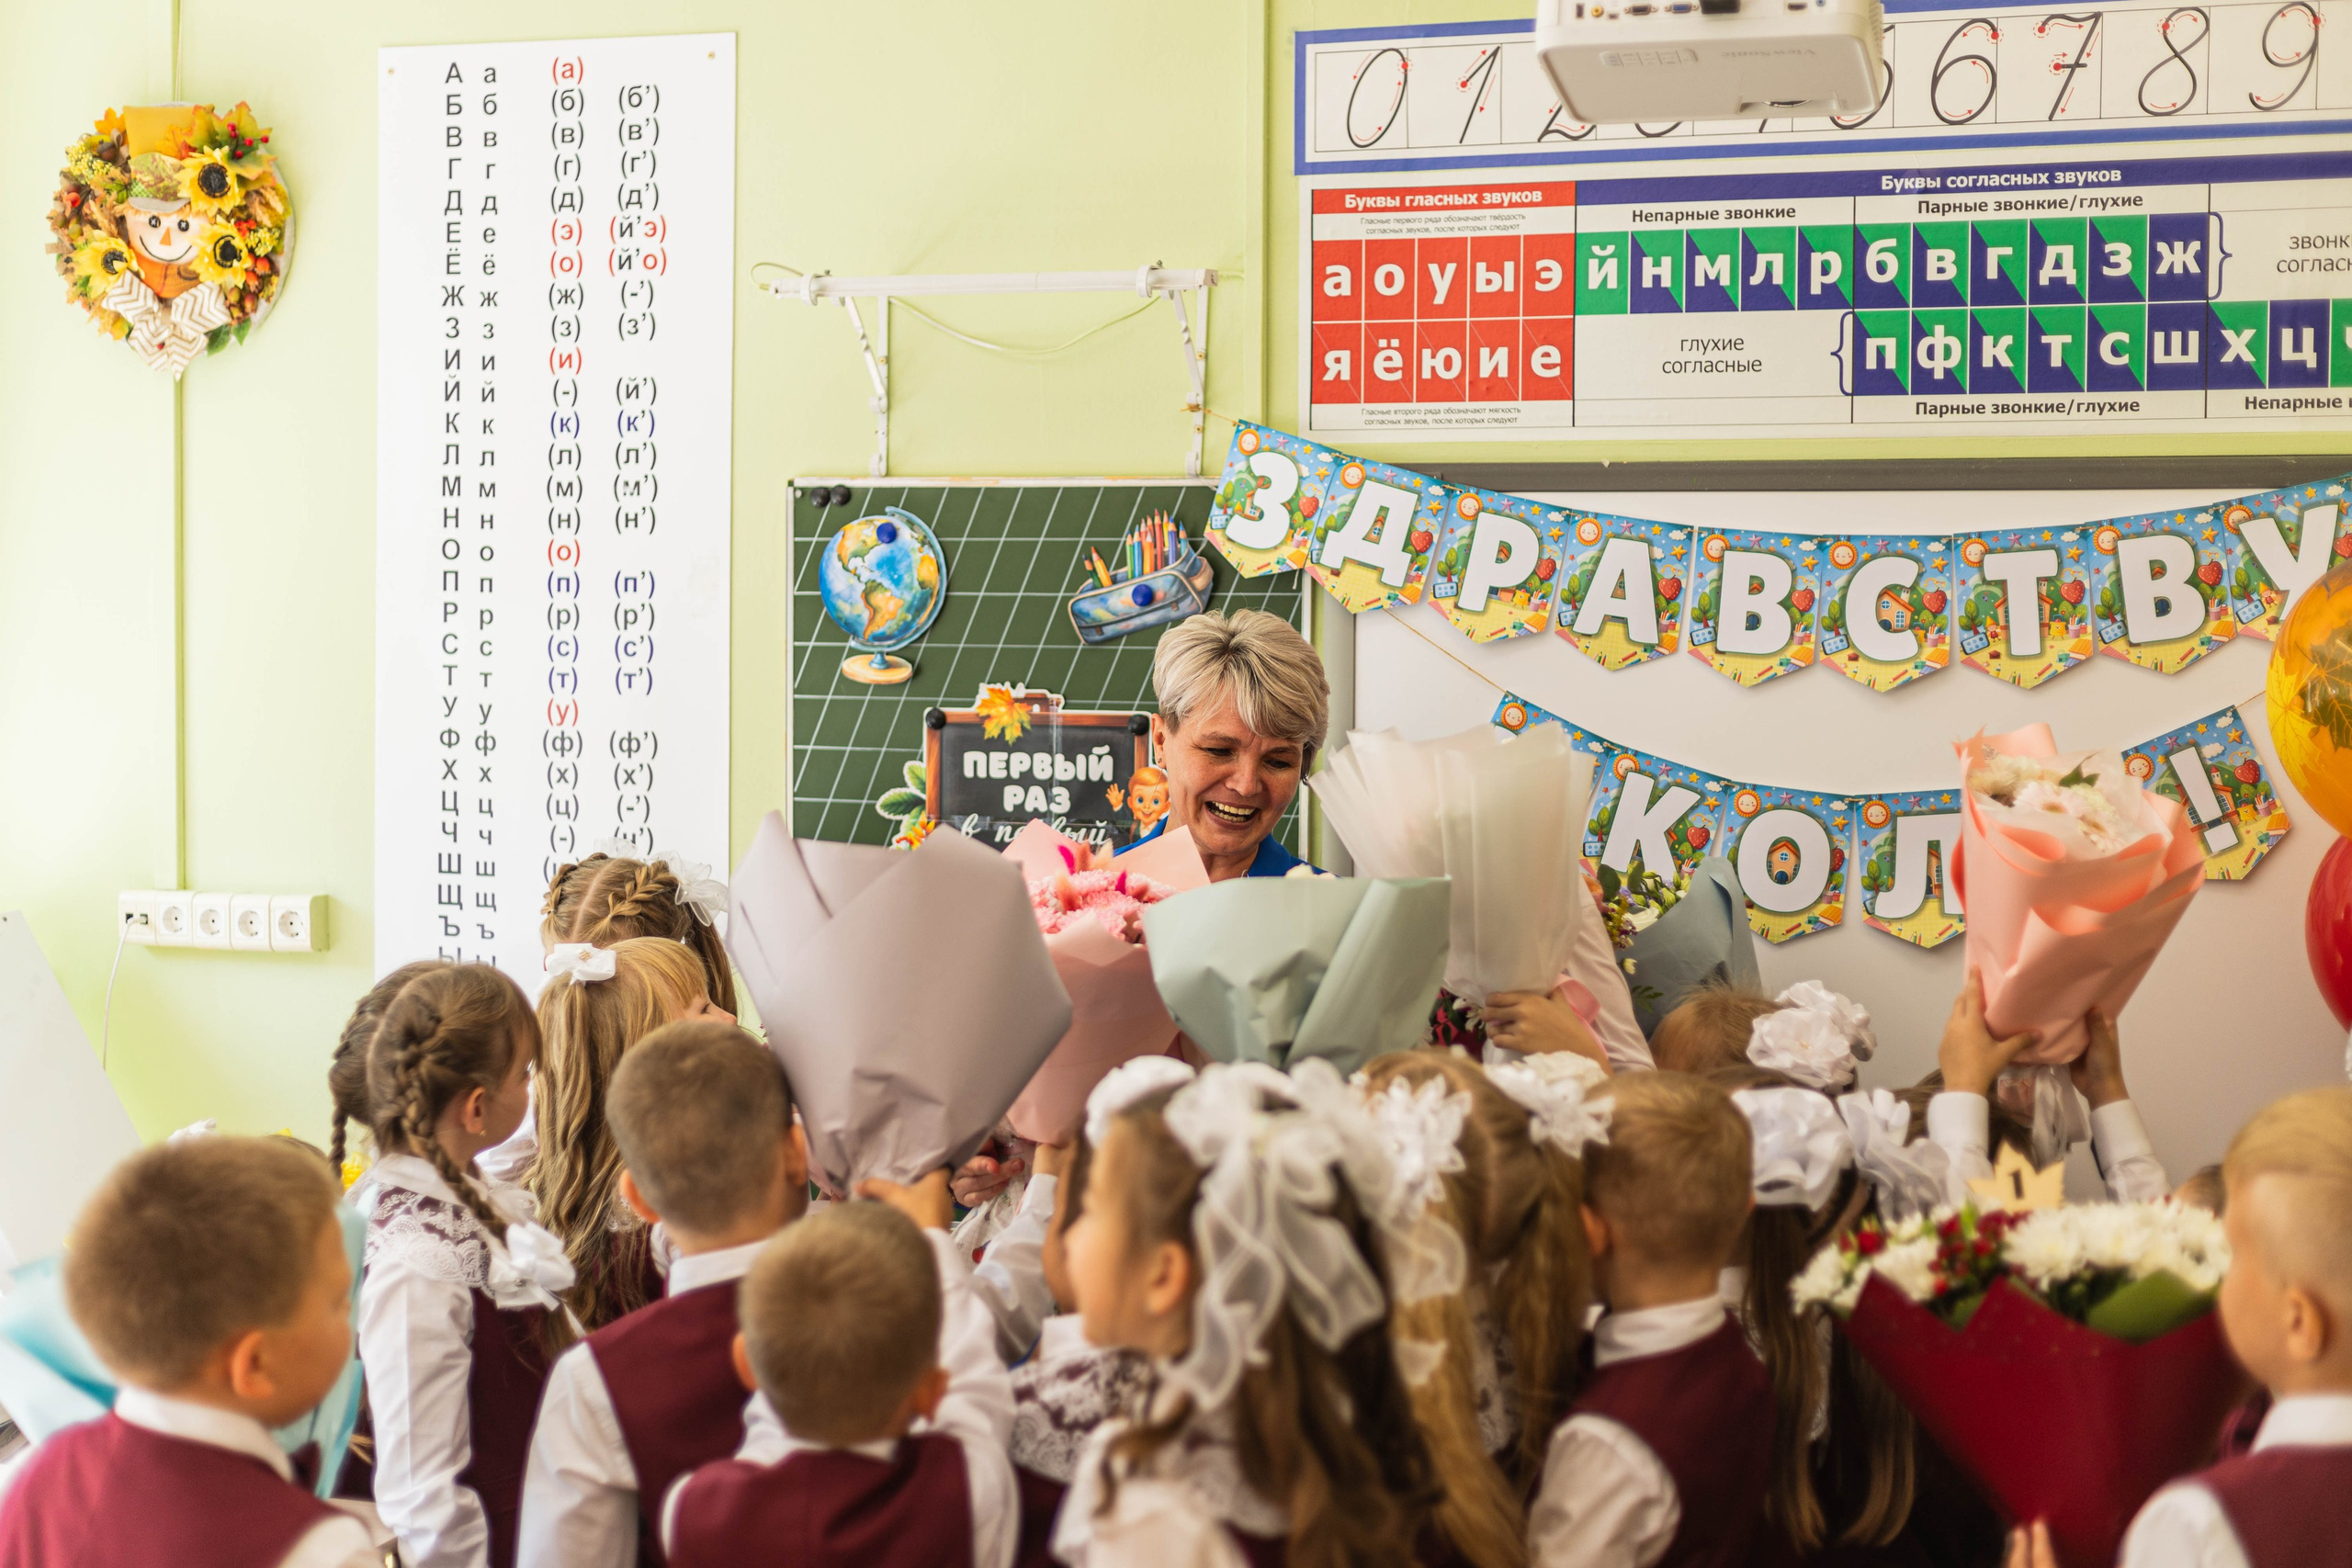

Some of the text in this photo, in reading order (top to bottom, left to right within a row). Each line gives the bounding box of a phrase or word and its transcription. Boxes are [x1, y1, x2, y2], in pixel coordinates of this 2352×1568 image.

[444, 56, 584, 86] А а (а)
[1346, 48, 1408, 149] 0
[1459, 45, 1501, 144] 1
[1930, 17, 1998, 126] 6
[2041, 11, 2103, 122] 7
[2138, 6, 2211, 118] 8
[2248, 1, 2319, 112] 9
[446, 88, 584, 118] Б б (б)
[446, 120, 584, 151] В в (в)
[448, 152, 582, 183] Г г (г)
[1881, 169, 2122, 194] Буквы согласных звуков
[444, 185, 584, 217] Д д (д)
[1344, 190, 1543, 211] Буквы гласных звуков
[1917, 194, 2143, 217] Парные звонкие/глухие
[1360, 213, 1527, 225] Гласные первого ряда обозначают твёрдость
[1488, 223, 1521, 231] следуют
[1632, 207, 1796, 225] Непарные звонкие
[446, 217, 583, 247] Е е (э)
[2290, 235, 2352, 250] звонк
[446, 247, 583, 279] Ё ё (о)
[1588, 237, 2201, 296] й н м л р б в г д з ж
[1323, 258, 1563, 305] а о у ы э
[441, 282, 584, 311] Ж ж (ж)
[445, 314, 582, 344] З з (з)
[444, 346, 582, 376] И и (и)
[1322, 338, 1561, 381] я ё ю и е
[1680, 337, 1745, 356] глухие
[1865, 337, 1897, 370] п
[1916, 324, 1962, 380] ф
[1982, 334, 2015, 368] к
[2041, 334, 2073, 367] т
[2098, 331, 2130, 367] с
[2153, 330, 2199, 365] ш
[2220, 328, 2257, 364] х
[2280, 327, 2317, 368] ц
[1662, 359, 1762, 374] согласные
[444, 371, 495, 403] Й й
[1361, 408, 1392, 416] Гласные
[1393, 408, 1422, 416] второго
[1423, 408, 1442, 416] ряда
[1442, 406, 1487, 415] обозначают
[1916, 399, 2141, 419] Парные звонкие/глухие
[2245, 396, 2343, 413] Непарные
[446, 411, 581, 440] К к (к)
[1363, 418, 1402, 426] согласных
[1403, 418, 1430, 426] звуков,
[1454, 417, 1486, 425] которых
[1487, 416, 1519, 424] следуют
[442, 442, 582, 471] Л л (л)
[442, 474, 583, 503] М м (м)
[443, 506, 582, 536] Н н (н)
[441, 537, 494, 562] О о
[442, 570, 493, 593] П п
[443, 602, 494, 631] Р р
[441, 633, 492, 657] С с
[442, 664, 492, 688] Т т
[442, 695, 492, 726] У у
[439, 728, 497, 757] Ф ф
[441, 758, 492, 783] Х х
[963, 744, 1114, 783] ПЕРВЫЙ
[441, 790, 494, 818] Ц ц
[1002, 784, 1072, 815] РАЗ
[441, 821, 492, 846] Ч ч
[437, 852, 496, 877] Ш ш
[437, 883, 497, 913] Щ щ
[437, 914, 495, 940] Ъ ъ
